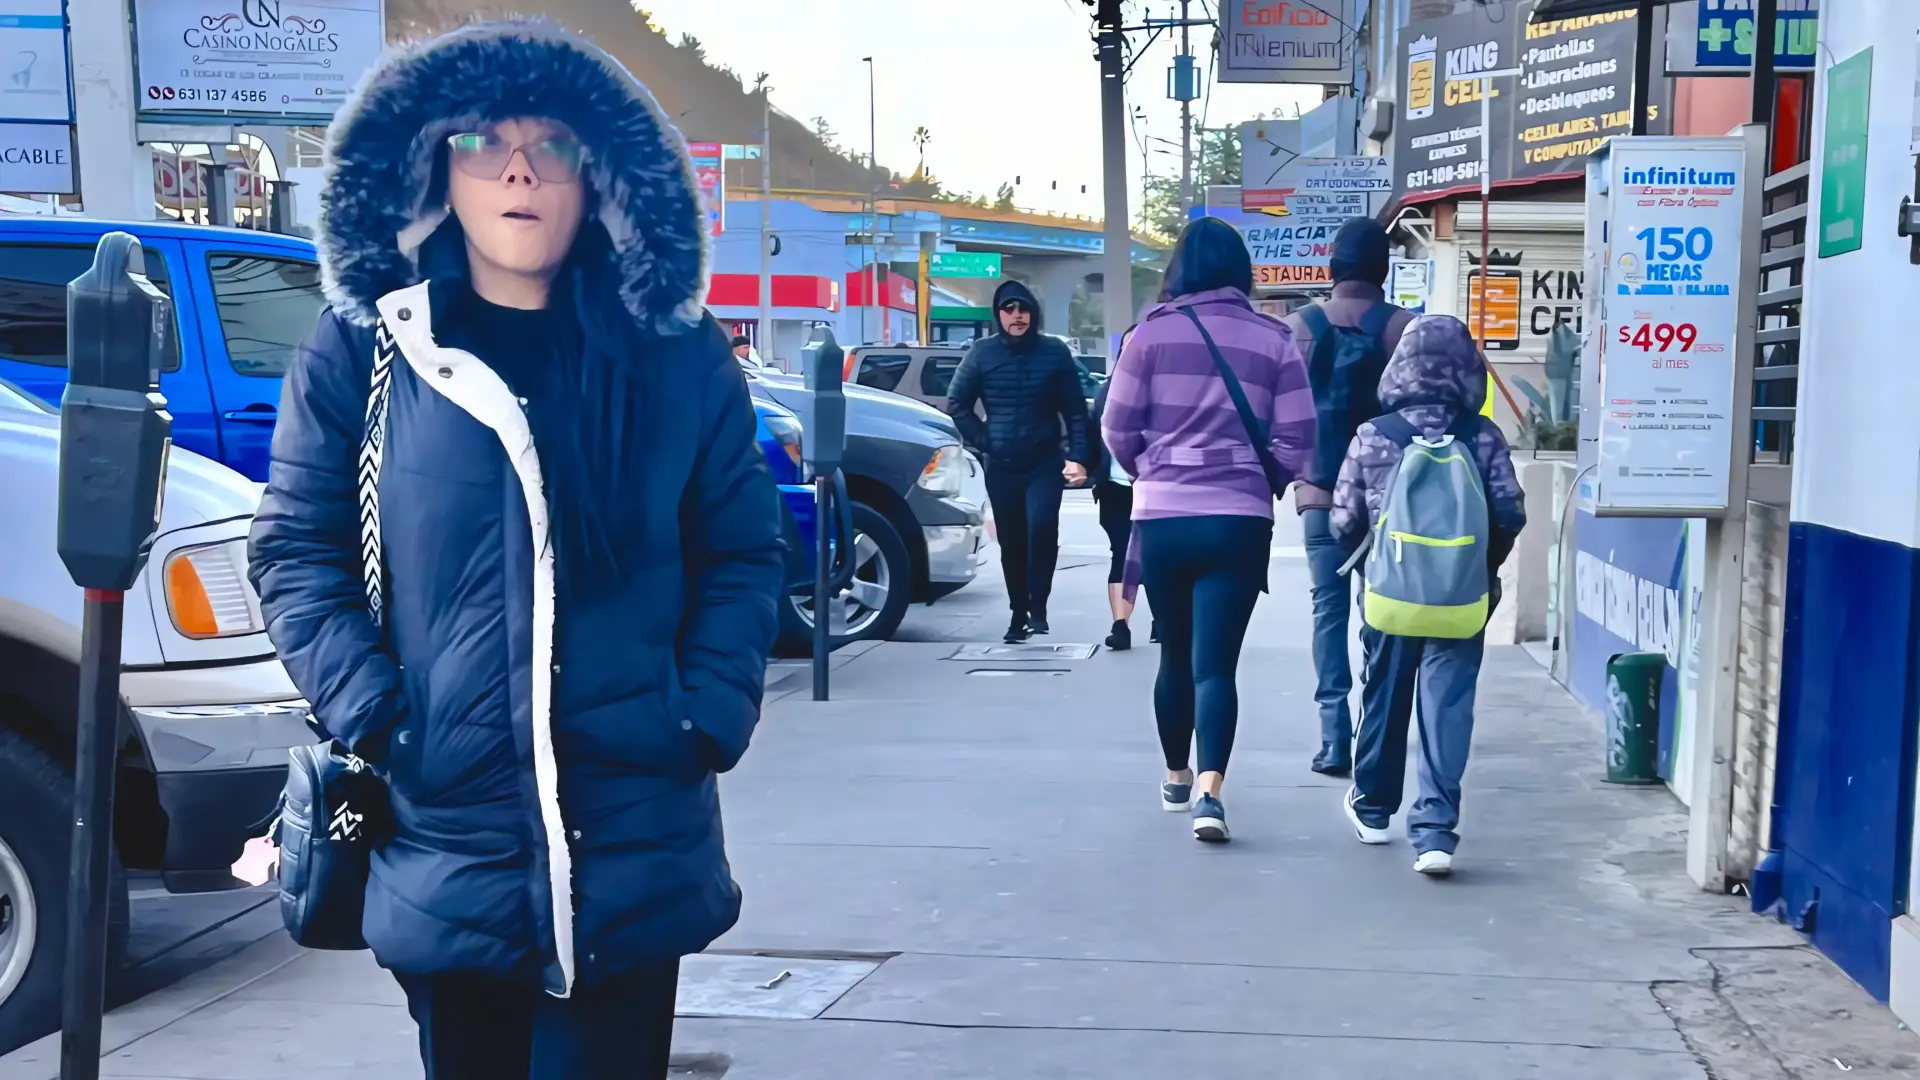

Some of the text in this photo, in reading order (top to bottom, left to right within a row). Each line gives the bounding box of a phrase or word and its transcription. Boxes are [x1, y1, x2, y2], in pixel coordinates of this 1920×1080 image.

[183, 28, 340, 53] CASINO NOGALES
[1445, 41, 1499, 80] KING
[1527, 58, 1617, 89] Liberaciones
[178, 88, 202, 100] 631
[231, 91, 267, 102] 4586
[1444, 78, 1500, 106] CELL
[1623, 166, 1736, 185] infinitum
[1252, 244, 1293, 258] THE
[1636, 226, 1713, 261] 150
[1646, 264, 1703, 281] MEGAS
[1618, 323, 1697, 352] $499
[1665, 359, 1690, 369] mes
